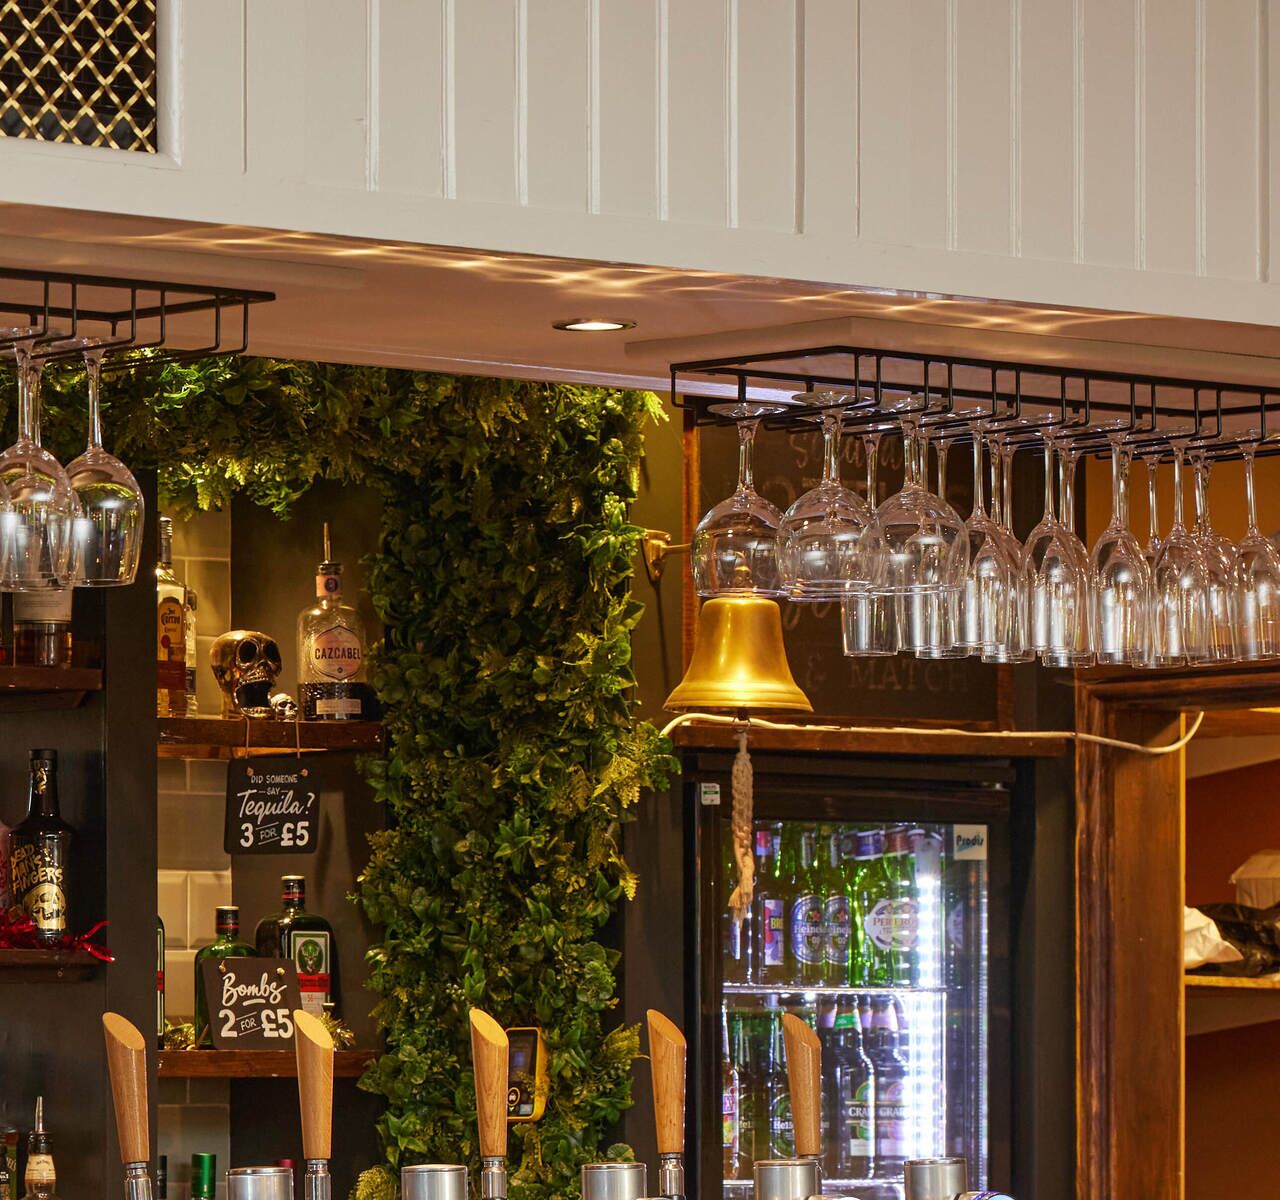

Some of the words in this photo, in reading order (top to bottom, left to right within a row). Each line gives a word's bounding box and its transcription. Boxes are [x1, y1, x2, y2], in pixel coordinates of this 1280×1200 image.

[314, 647, 361, 660] CAZCABEL
[250, 775, 264, 784] DID
[266, 774, 299, 784] SOMEONE
[266, 787, 281, 796] SAY
[237, 789, 316, 825] Tequila?
[240, 822, 254, 848] 3
[260, 828, 278, 841] FOR
[280, 821, 310, 847] £5
[12, 867, 64, 895] FINGERS
[222, 972, 288, 1007] Bombs
[218, 1008, 238, 1038] 2
[240, 1017, 257, 1031] FOR
[260, 1008, 294, 1039] £5
